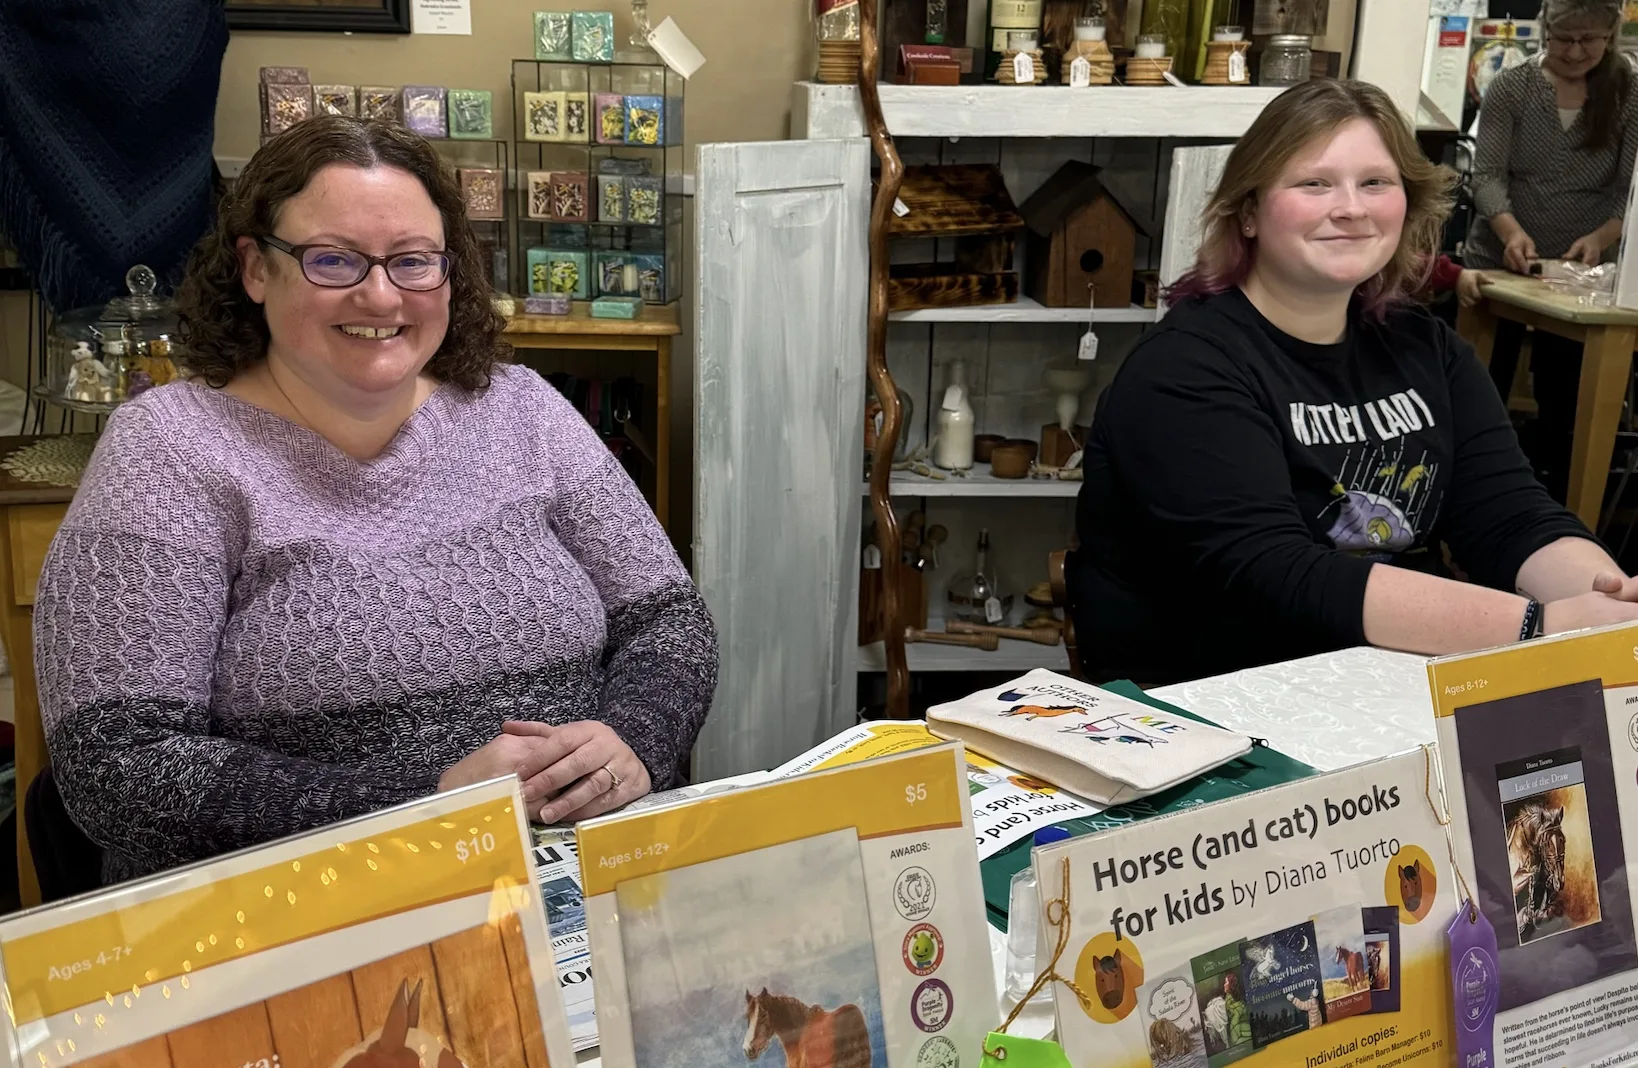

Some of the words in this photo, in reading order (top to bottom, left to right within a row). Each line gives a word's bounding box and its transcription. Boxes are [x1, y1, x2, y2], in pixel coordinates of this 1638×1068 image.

[1025, 686, 1098, 708] AUTHORS
[1049, 684, 1100, 702] OTHER
[1445, 683, 1465, 696] Ages
[1466, 678, 1488, 691] 8-12+
[1130, 715, 1187, 734] ME
[905, 782, 927, 806] $5
[1515, 780, 1530, 792] Luck
[1532, 777, 1539, 787] of
[1540, 776, 1550, 786] the
[1551, 773, 1569, 784] Draw
[985, 795, 1029, 811] kids
[1028, 802, 1085, 816] Horse
[984, 812, 1032, 838] (and
[455, 832, 497, 865] $10
[1093, 844, 1185, 892] Horse
[1191, 818, 1259, 871] (and
[1265, 804, 1319, 843] cat)
[1325, 783, 1402, 827] books
[599, 849, 632, 869] Ages
[634, 843, 671, 861] 8-12+
[889, 842, 931, 860] AWARDS:
[1110, 907, 1158, 942] for
[1164, 882, 1225, 926] kids
[1231, 879, 1258, 908] by
[1266, 860, 1328, 895] Diana
[1331, 837, 1401, 874] Tuorto
[909, 901, 926, 912] 2021
[48, 957, 92, 983] Ages
[95, 945, 134, 971] 4-7+
[1268, 967, 1290, 983] angel
[1290, 962, 1314, 977] horses
[1283, 978, 1316, 995] unicorns
[1502, 1022, 1524, 1034] Written
[1525, 1017, 1538, 1026] from
[1539, 1012, 1548, 1021] the
[1548, 1006, 1569, 1019] horse's
[1570, 1001, 1585, 1013] point
[1586, 998, 1592, 1006] of
[1607, 987, 1629, 999] Despite
[1503, 1031, 1527, 1045] slowest
[1527, 1021, 1558, 1035] racehorses
[1558, 1016, 1571, 1026] ever
[1594, 1002, 1609, 1014] Lucky
[1610, 996, 1632, 1008] remains
[1529, 1038, 1538, 1046] He
[1545, 1025, 1576, 1041] determined
[1584, 1018, 1595, 1028] find
[1596, 1015, 1604, 1023] his
[1618, 1004, 1638, 1016] purpos
[1306, 1037, 1359, 1068] Individual
[1361, 1024, 1399, 1049] copies:
[1391, 1035, 1419, 1053] Manager:
[1419, 1029, 1431, 1040] $10
[1402, 1044, 1431, 1062] Unicorns:
[1432, 1039, 1443, 1051] $10
[1505, 1053, 1524, 1065] learns
[1525, 1049, 1537, 1058] that
[1538, 1038, 1570, 1054] succeeding
[1577, 1031, 1586, 1040] life
[1607, 1018, 1626, 1030] always
[1627, 1014, 1638, 1023] invo
[1466, 1047, 1487, 1068] Purple
[1532, 1056, 1543, 1066] and
[1544, 1050, 1566, 1063] ribbons.
